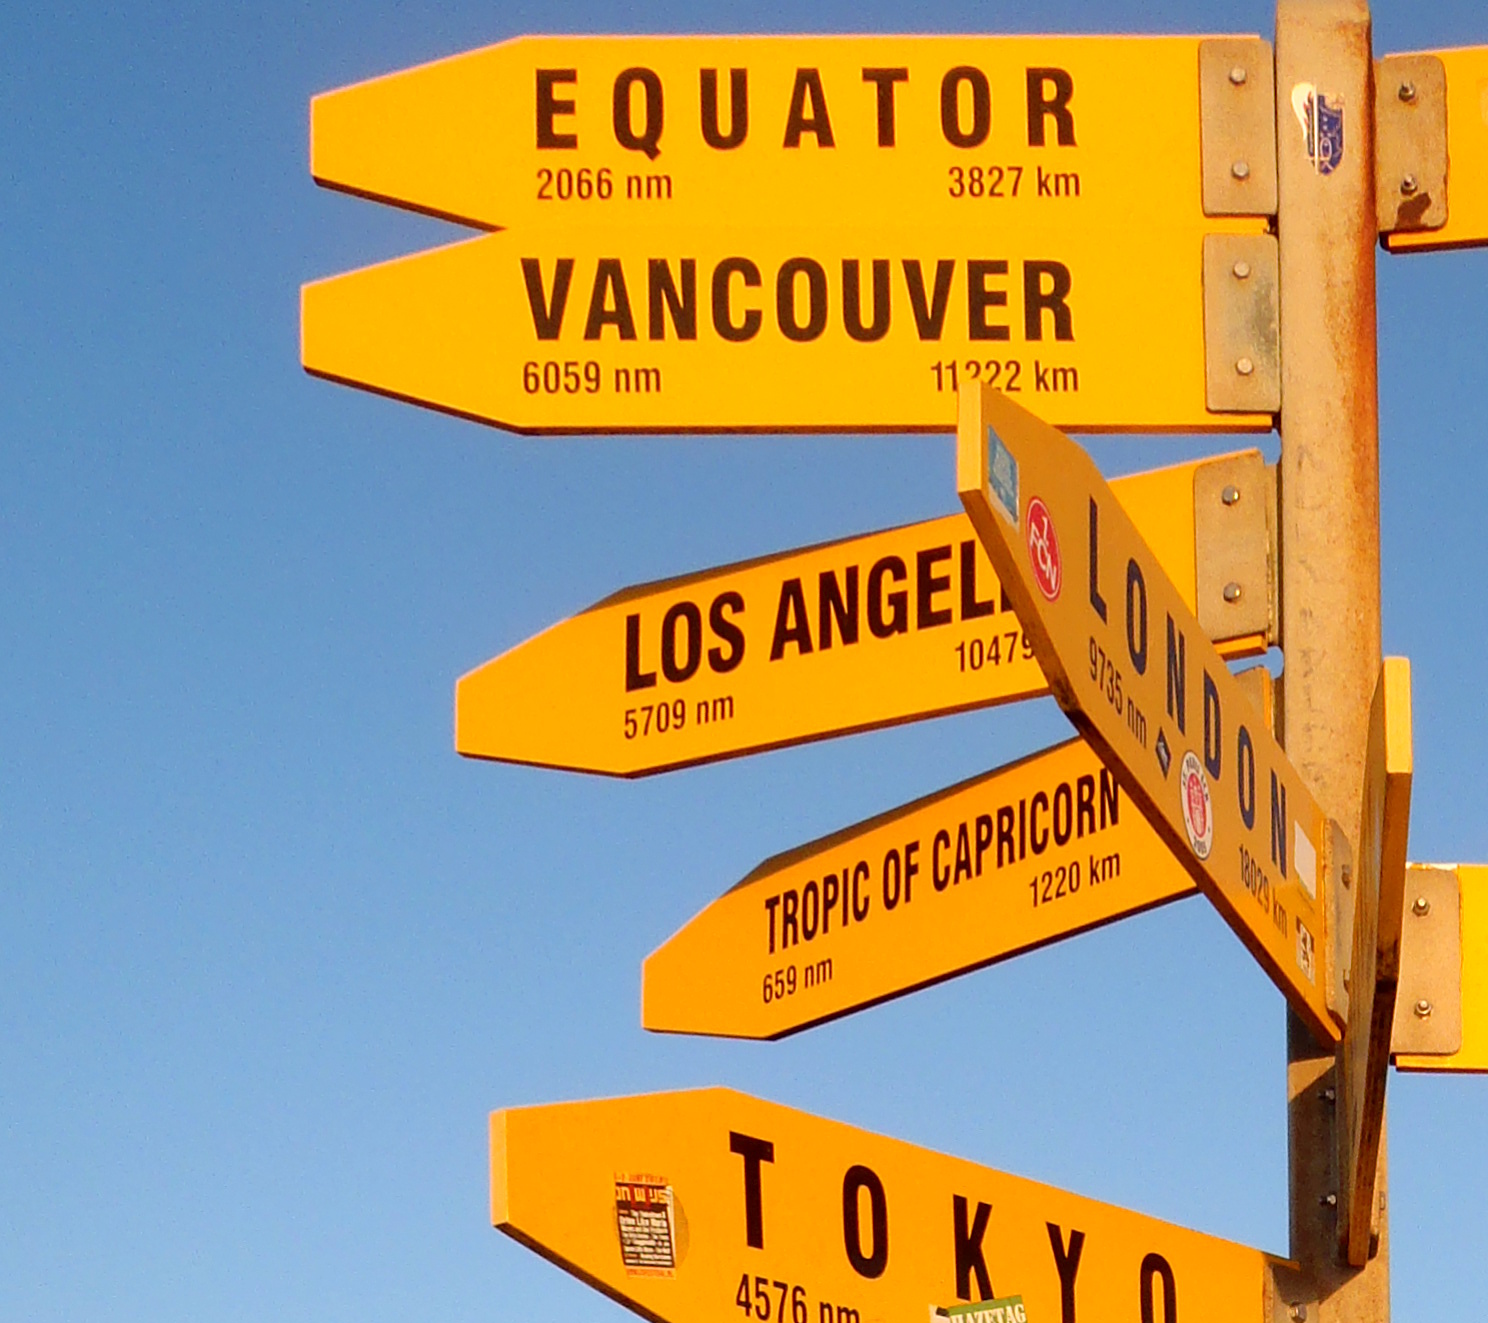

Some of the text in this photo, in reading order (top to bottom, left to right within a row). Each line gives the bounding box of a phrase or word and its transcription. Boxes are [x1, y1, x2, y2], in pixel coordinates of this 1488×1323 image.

[536, 66, 1078, 160] EQUATOR
[537, 168, 672, 200] 2066 nm
[949, 166, 1080, 198] 3827 km
[520, 257, 1075, 343] VANCOUVER
[523, 361, 661, 394] 6059 nm
[1034, 360, 1078, 392] km
[624, 539, 1014, 692] LOS ANGEL
[955, 630, 1034, 673] 10479
[1088, 495, 1287, 881] LONDON
[1088, 636, 1147, 748] 9735 nm
[624, 695, 734, 740] 5709 nm
[764, 861, 870, 954] TROPIC
[882, 840, 920, 910] OF
[934, 768, 1121, 891] CAPRICORN
[1029, 853, 1120, 908] 1220 km
[1239, 843, 1288, 939] 18029 km
[763, 958, 833, 1004] 659 nm
